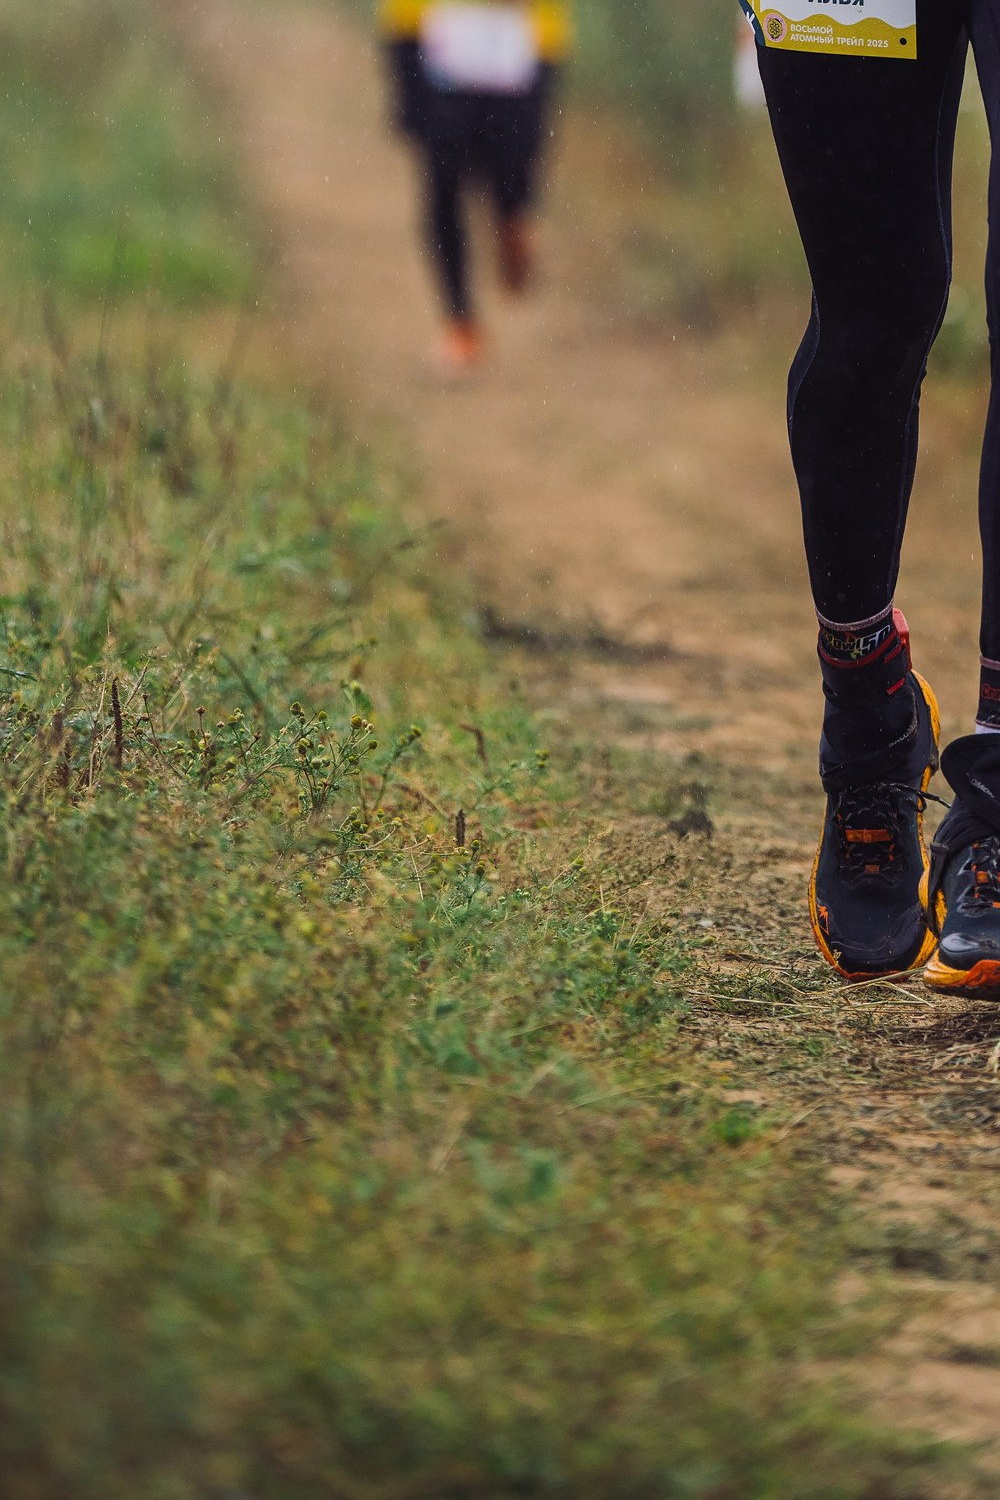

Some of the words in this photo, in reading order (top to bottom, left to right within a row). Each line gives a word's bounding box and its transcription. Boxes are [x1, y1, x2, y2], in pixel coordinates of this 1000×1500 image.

[790, 23, 833, 35] ВОСЬМОЙ
[790, 34, 834, 44] АТОМНЫЙ
[836, 37, 864, 46] ТРЕЙЛ
[866, 39, 889, 48] 2025
